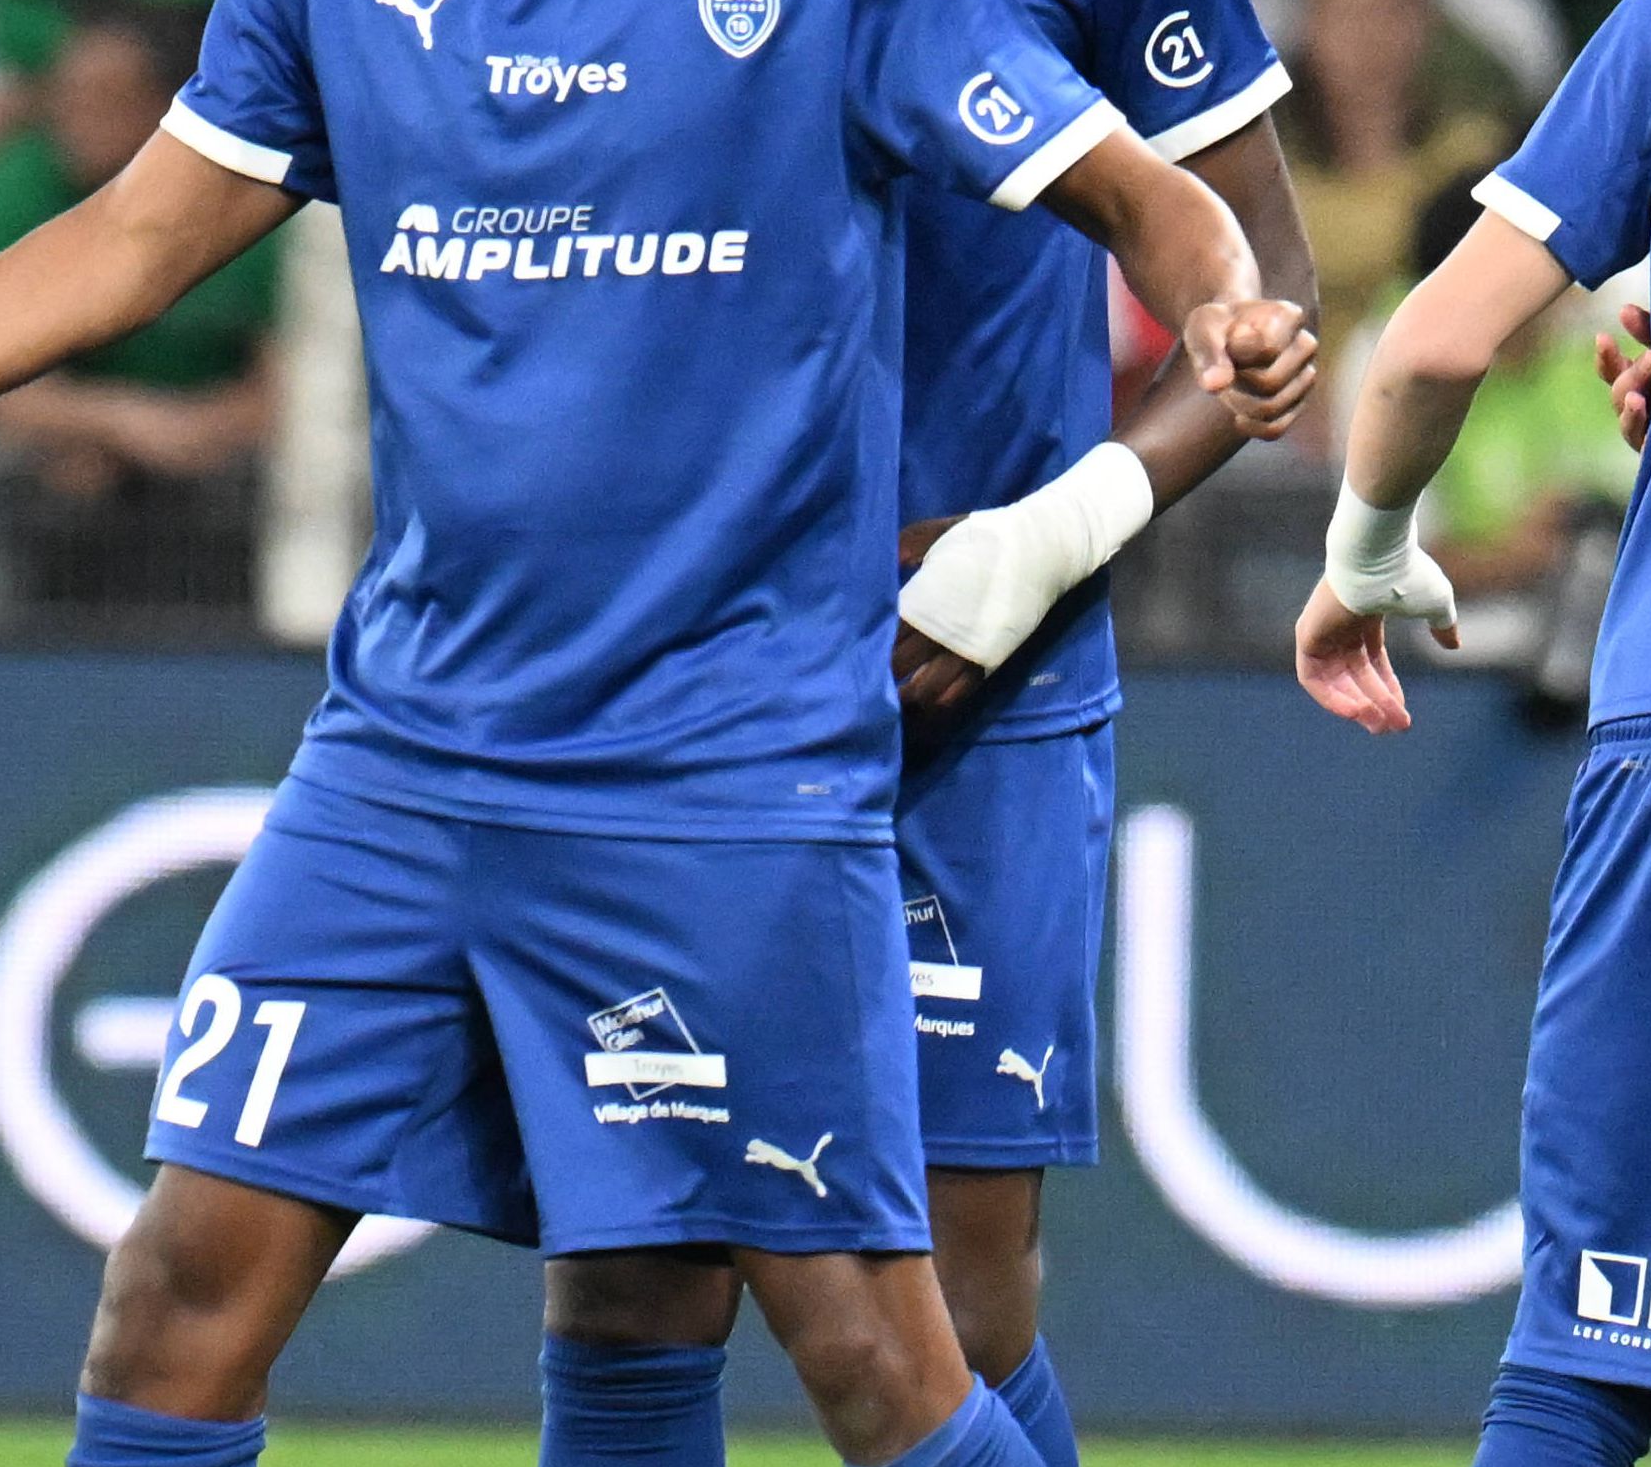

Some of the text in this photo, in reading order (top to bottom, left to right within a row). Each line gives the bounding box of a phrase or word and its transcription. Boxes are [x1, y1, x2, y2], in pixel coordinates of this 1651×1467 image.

[485, 55, 628, 103] Troyes
[451, 205, 595, 234] GROUPE
[378, 229, 750, 281] AMPLITUDE
[155, 973, 307, 1149] 21
[1572, 1323, 1603, 1341] LES
